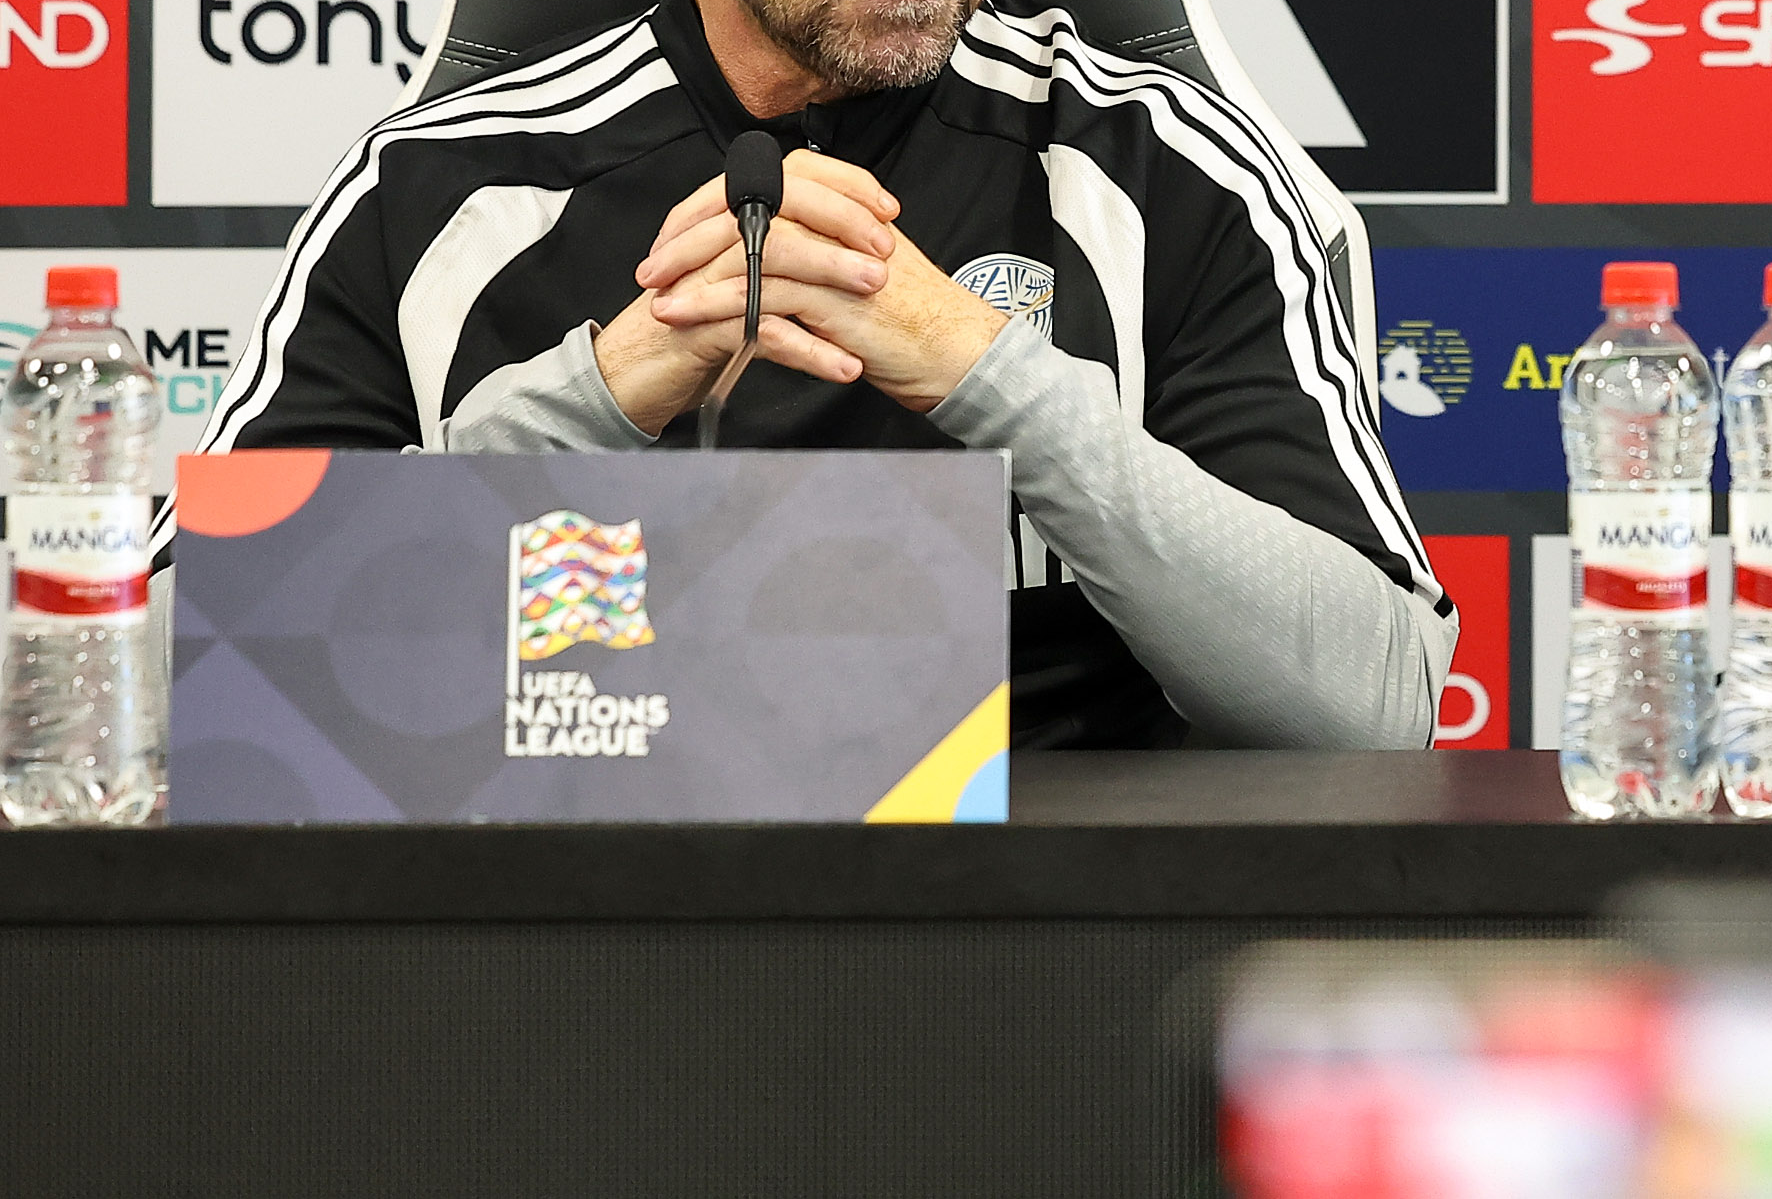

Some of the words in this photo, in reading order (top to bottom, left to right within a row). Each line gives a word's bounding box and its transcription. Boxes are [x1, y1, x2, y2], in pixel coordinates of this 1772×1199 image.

[522, 671, 596, 699] UEFA
[506, 693, 671, 728] NATIONS
[505, 724, 650, 757] LEAGUE
